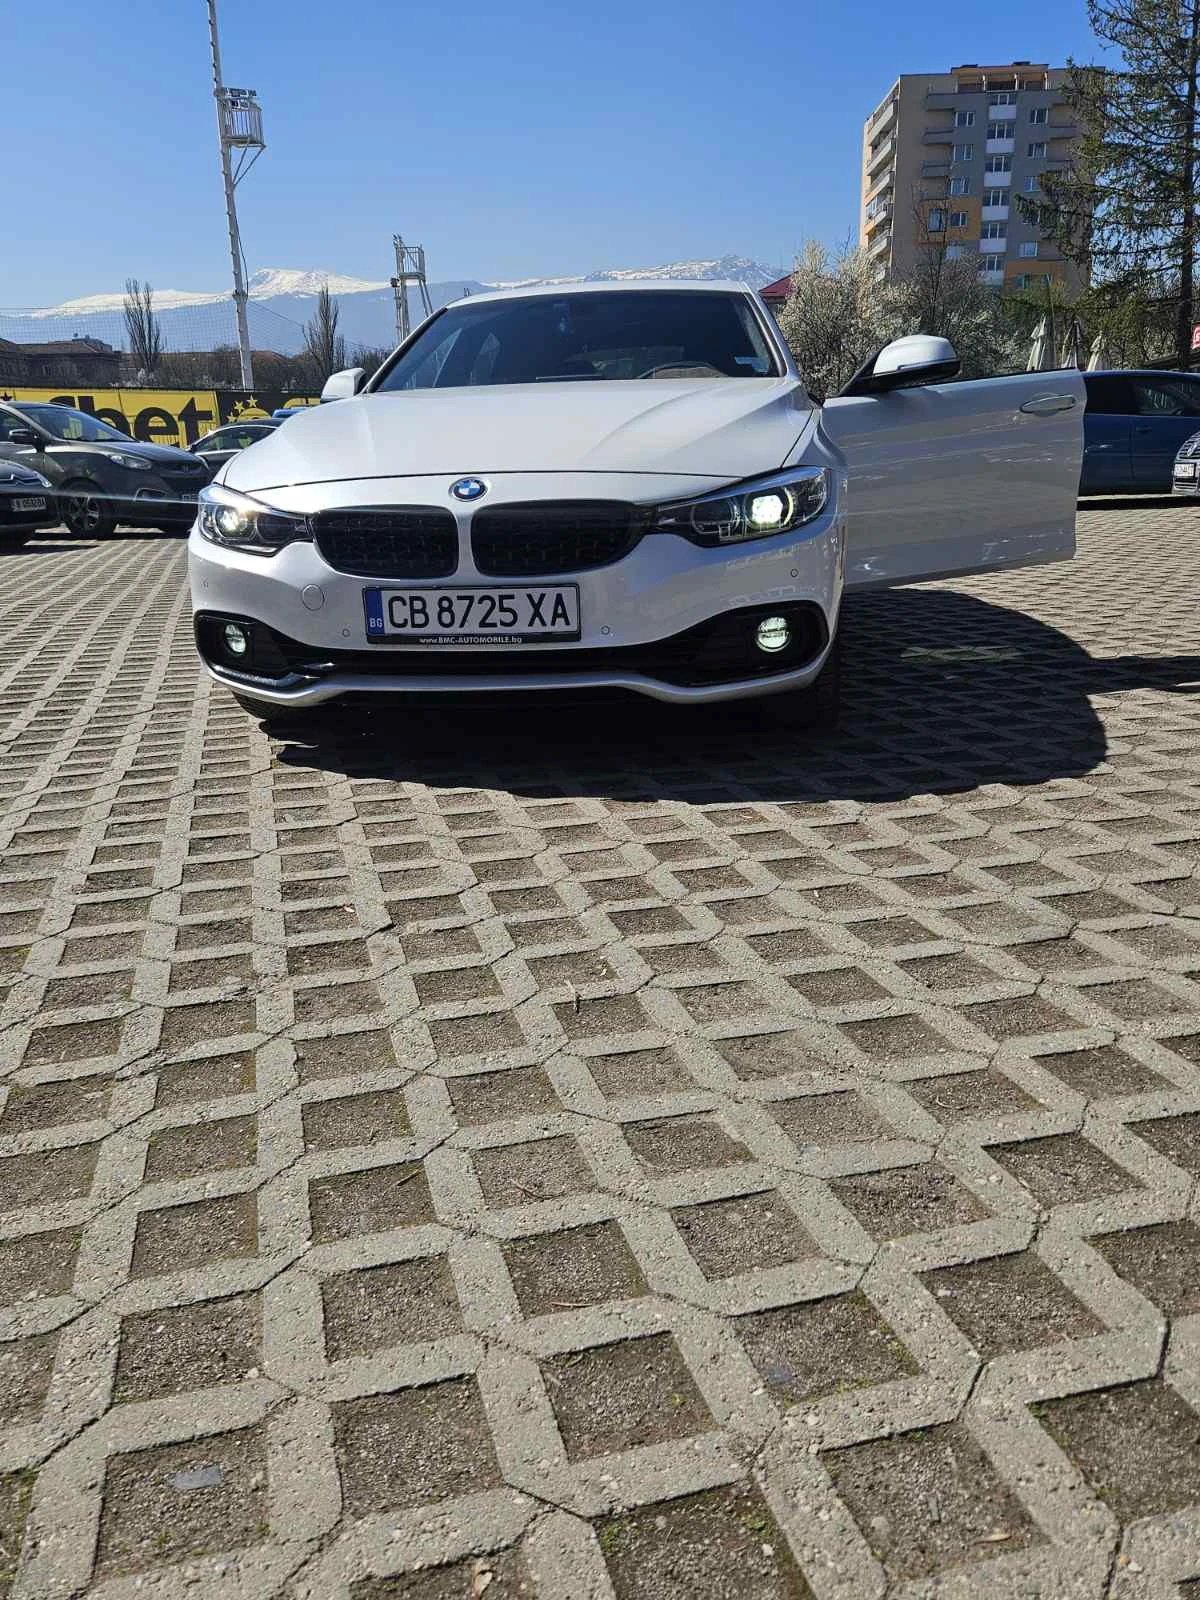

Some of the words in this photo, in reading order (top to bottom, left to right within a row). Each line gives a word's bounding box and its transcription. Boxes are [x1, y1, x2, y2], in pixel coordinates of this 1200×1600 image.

[388, 595, 430, 629] CB
[438, 594, 518, 628] 8725
[526, 593, 570, 628] XA
[369, 619, 383, 628] BG
